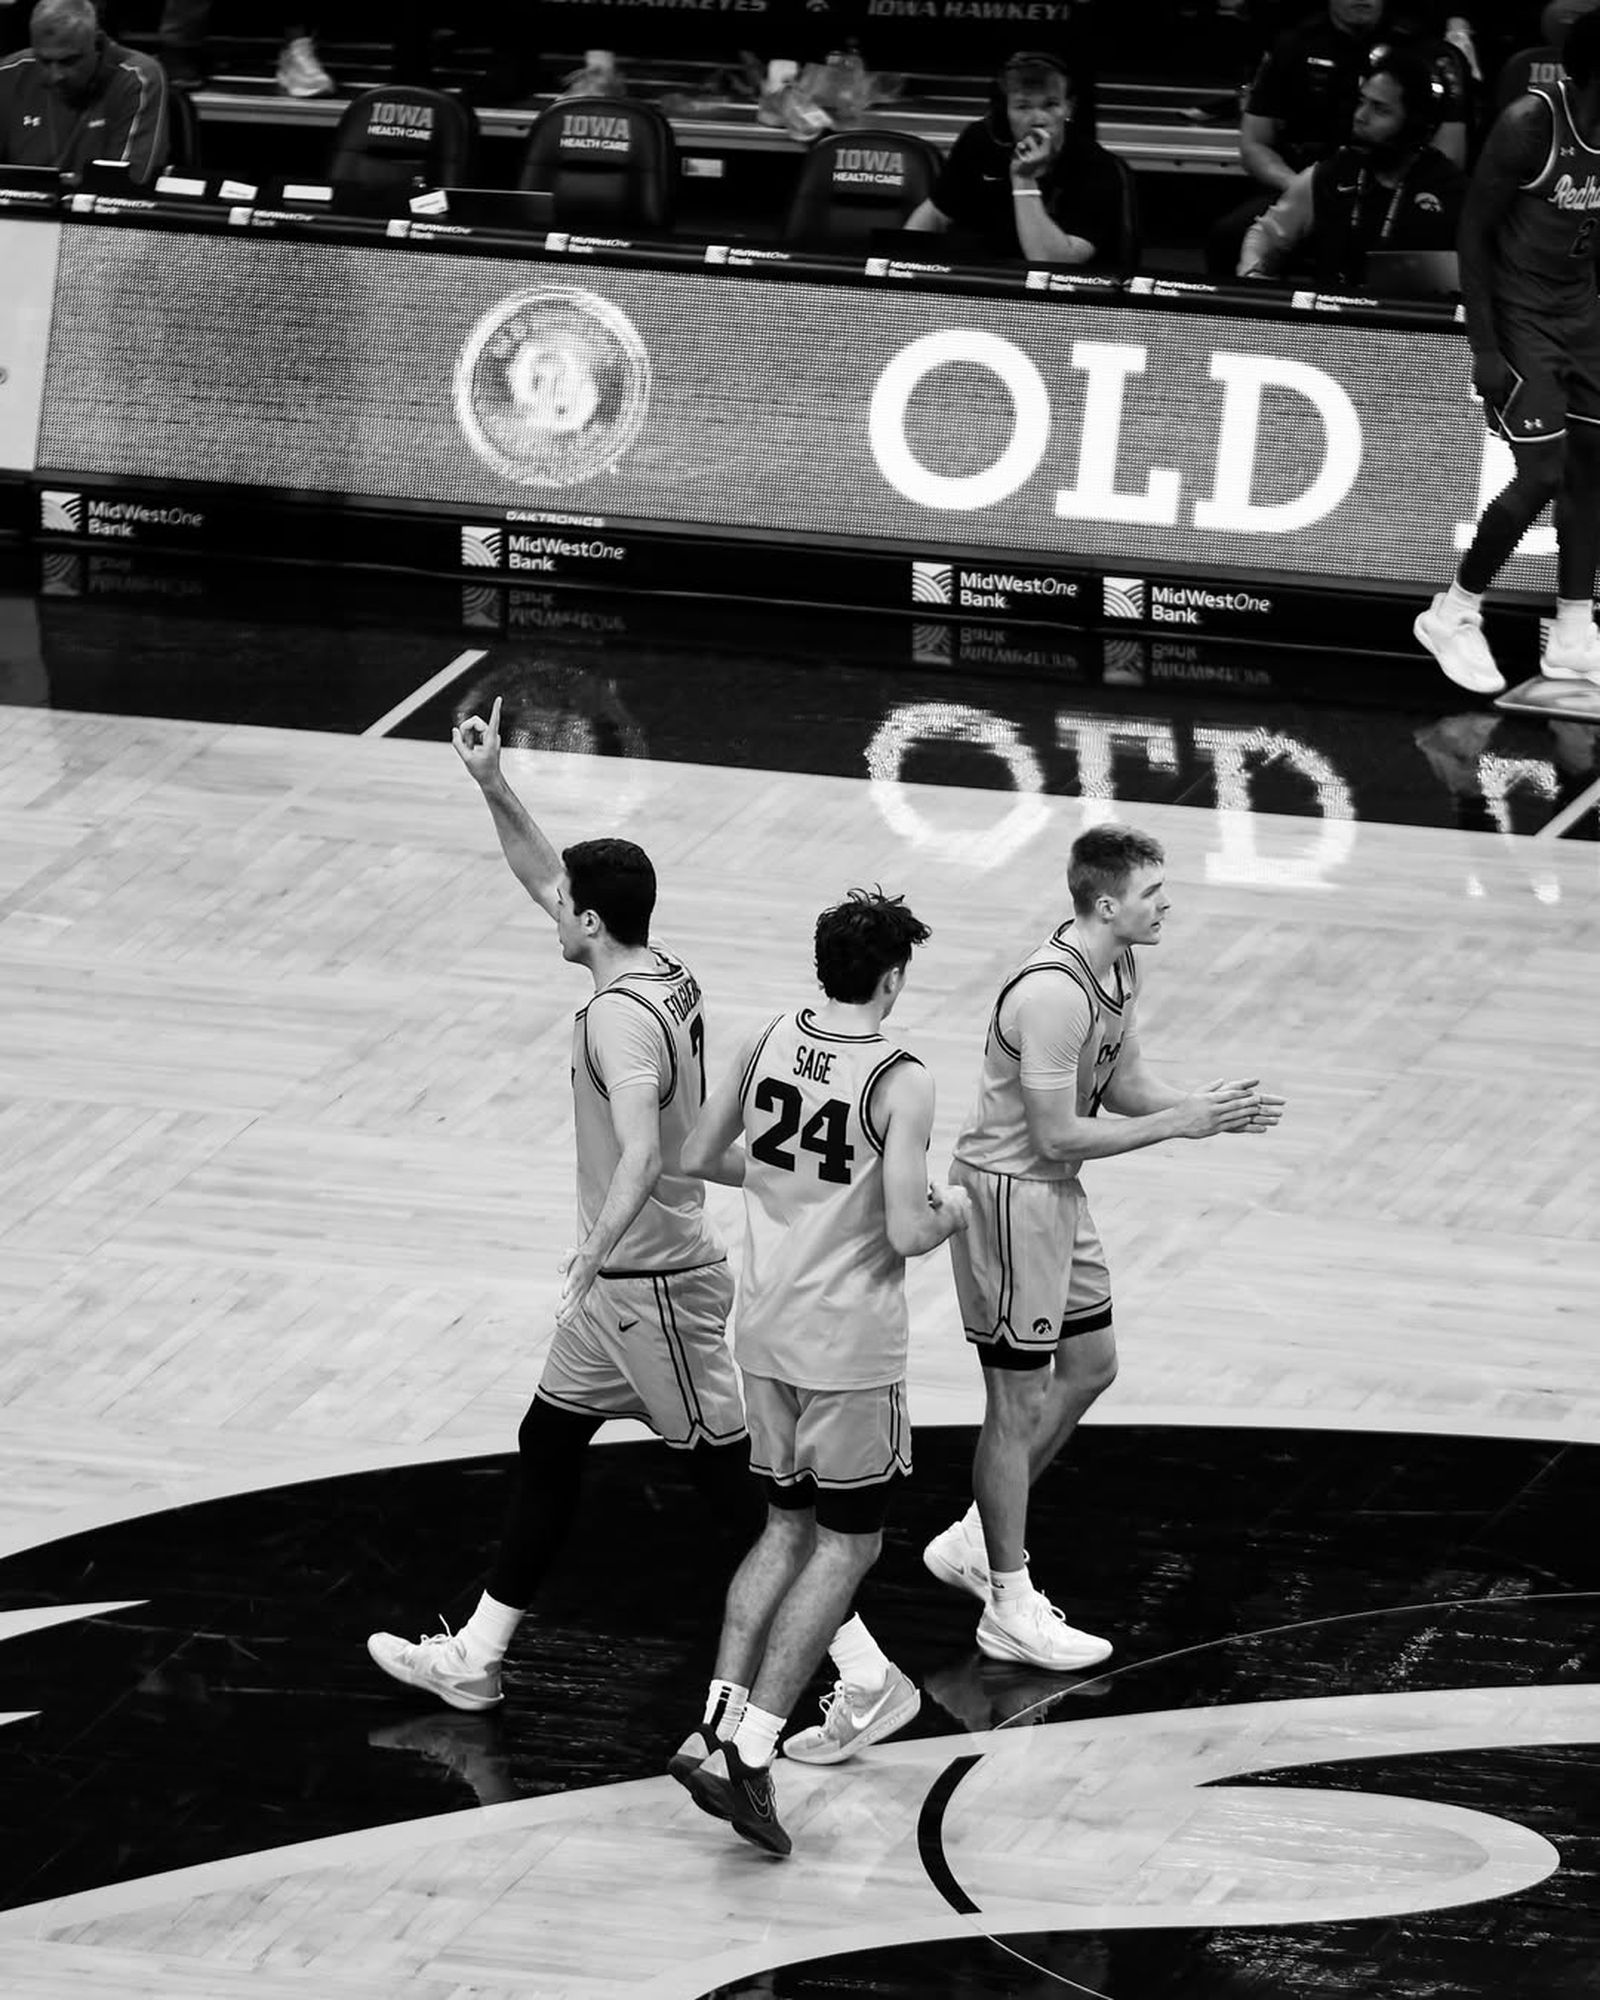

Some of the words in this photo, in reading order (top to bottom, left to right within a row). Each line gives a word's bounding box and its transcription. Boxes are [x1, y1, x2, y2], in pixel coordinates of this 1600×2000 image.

[867, 0, 937, 17] IOWA
[370, 102, 433, 128] IOWA
[562, 115, 629, 139] IOWA
[367, 125, 405, 137] HEALTH
[560, 138, 600, 149] HEALTH
[835, 149, 903, 173] IOWA
[833, 172, 874, 182] HEALTH
[875, 174, 903, 186] CARE
[868, 328, 1365, 534] OLD
[88, 500, 203, 527] MidWestOne
[505, 511, 606, 527] DAKTRONICS
[88, 517, 136, 537] Bank
[508, 535, 626, 560] MidWestOne
[508, 552, 556, 571] Bank
[960, 571, 1080, 597] MidWestOne
[960, 589, 1008, 608] Bank
[1152, 586, 1271, 612] MidWestOne
[1152, 604, 1201, 624] Bank
[793, 1046, 837, 1085] SAGE
[752, 1077, 855, 1185] 24
